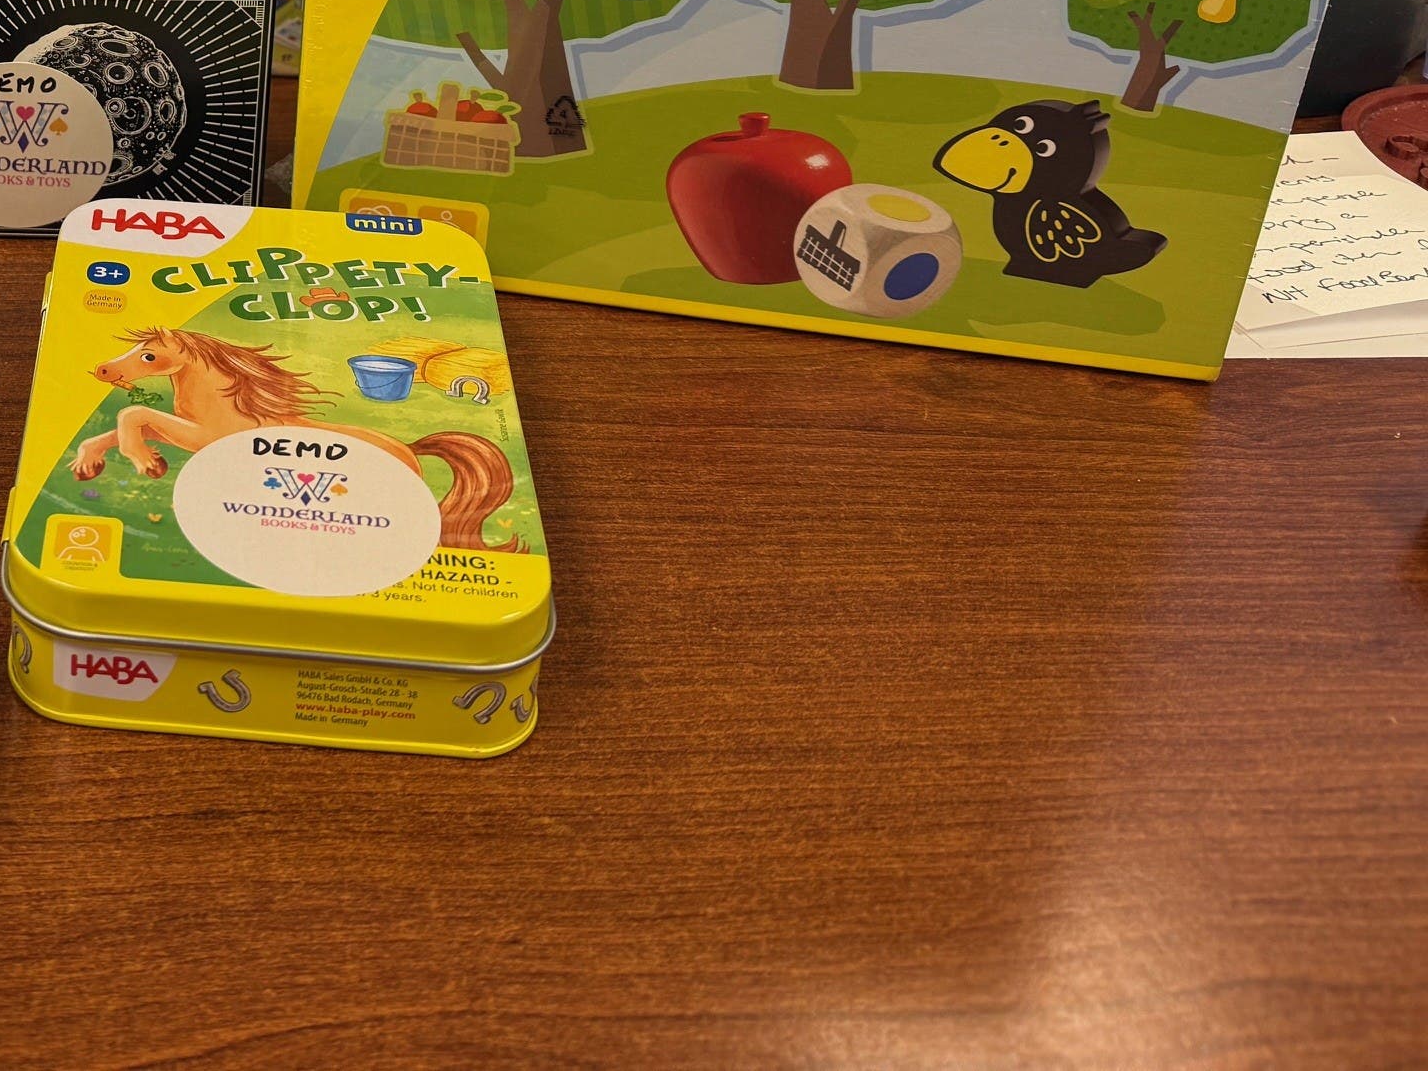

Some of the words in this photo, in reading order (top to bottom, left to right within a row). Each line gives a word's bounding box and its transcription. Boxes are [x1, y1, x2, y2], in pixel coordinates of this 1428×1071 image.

[36, 175, 71, 189] TOYS
[91, 208, 225, 240] HABA
[354, 215, 416, 234] mini
[94, 266, 123, 279] 3+
[151, 247, 481, 296] CLIPPETY-
[86, 300, 123, 310] Germany
[89, 294, 112, 302] Made
[228, 289, 431, 323] CLOP!
[252, 437, 349, 461] DEMO
[223, 501, 390, 531] WONDERLAND
[261, 519, 306, 533] BOOKS
[322, 522, 357, 536] TOYS
[70, 653, 158, 686] HABA
[298, 670, 321, 680] HABA
[324, 672, 345, 682] Sales
[346, 674, 372, 684] GmbH
[296, 691, 323, 701] 96476
[324, 692, 340, 702] Bad
[376, 698, 413, 710] Germany
[295, 703, 416, 719] www.haba-play.com
